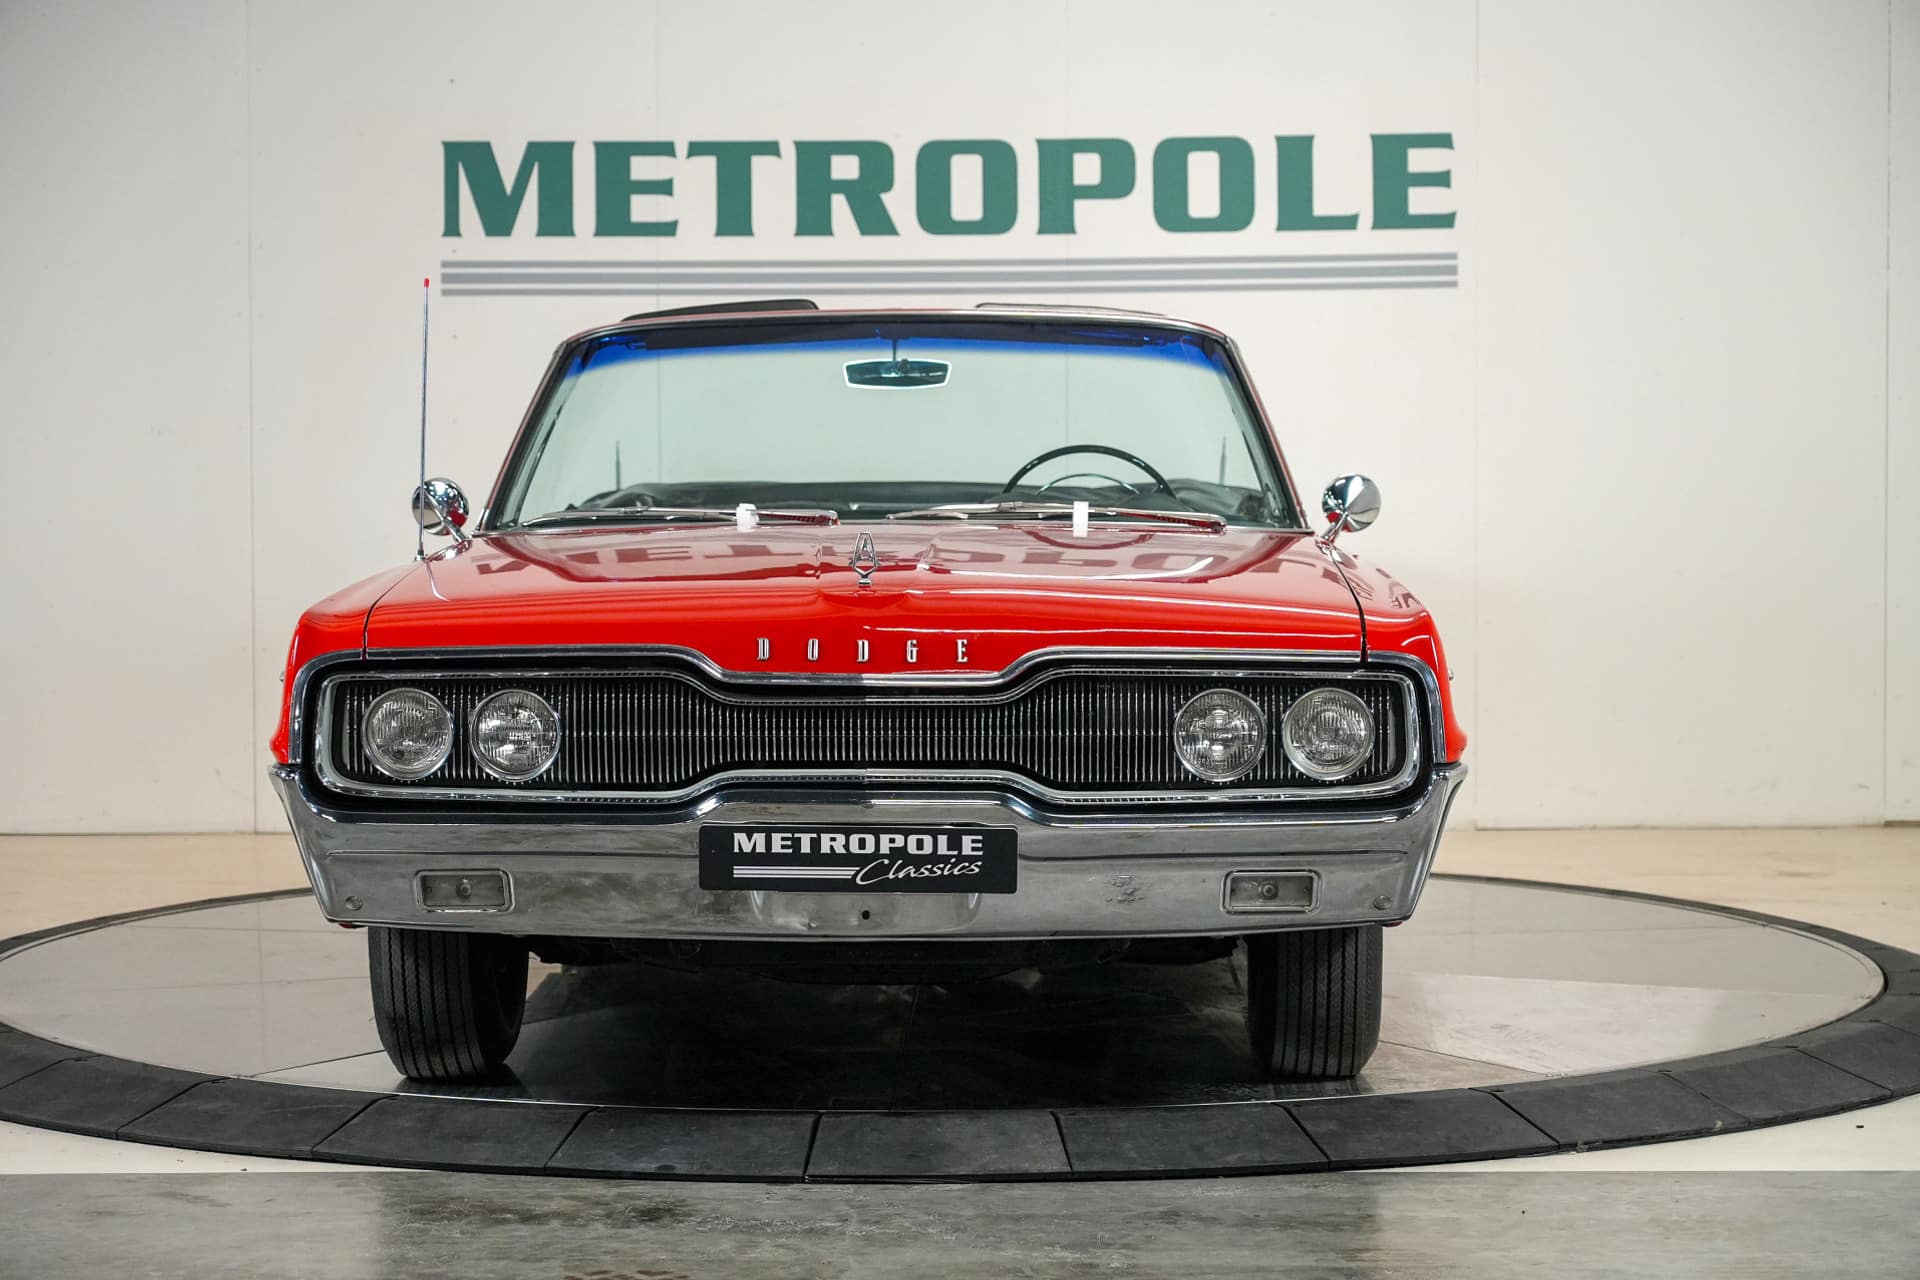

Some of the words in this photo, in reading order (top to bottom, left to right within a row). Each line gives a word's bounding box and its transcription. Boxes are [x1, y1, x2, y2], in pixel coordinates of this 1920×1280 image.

[441, 132, 1456, 238] METROPOLE
[756, 637, 968, 663] DODGE
[733, 832, 984, 855] METROPOLE
[855, 857, 983, 885] Classics
